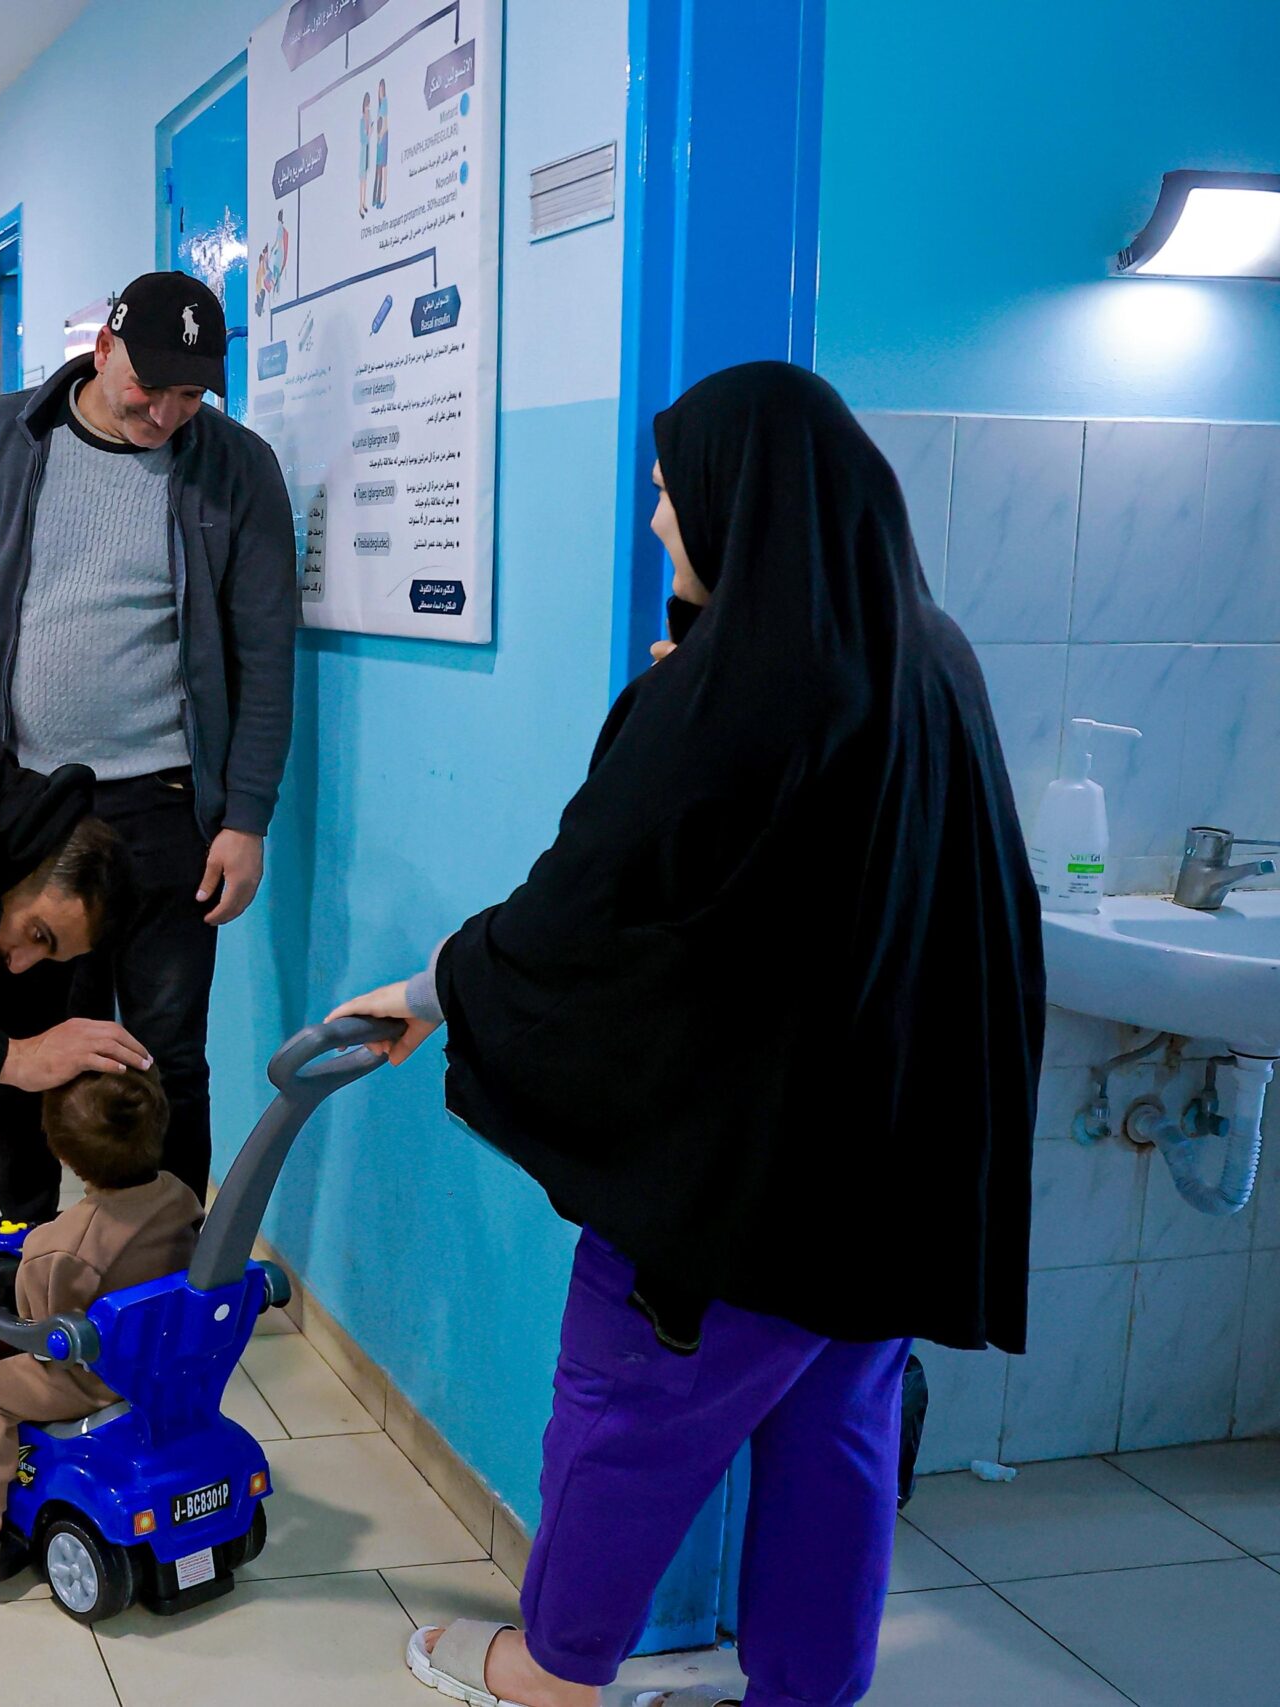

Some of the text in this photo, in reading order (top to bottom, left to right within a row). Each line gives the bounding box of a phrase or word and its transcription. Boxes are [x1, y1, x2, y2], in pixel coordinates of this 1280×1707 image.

[112, 303, 128, 331] 3
[421, 313, 450, 331] Basal insulin
[175, 1483, 229, 1522] J-BC8301P
